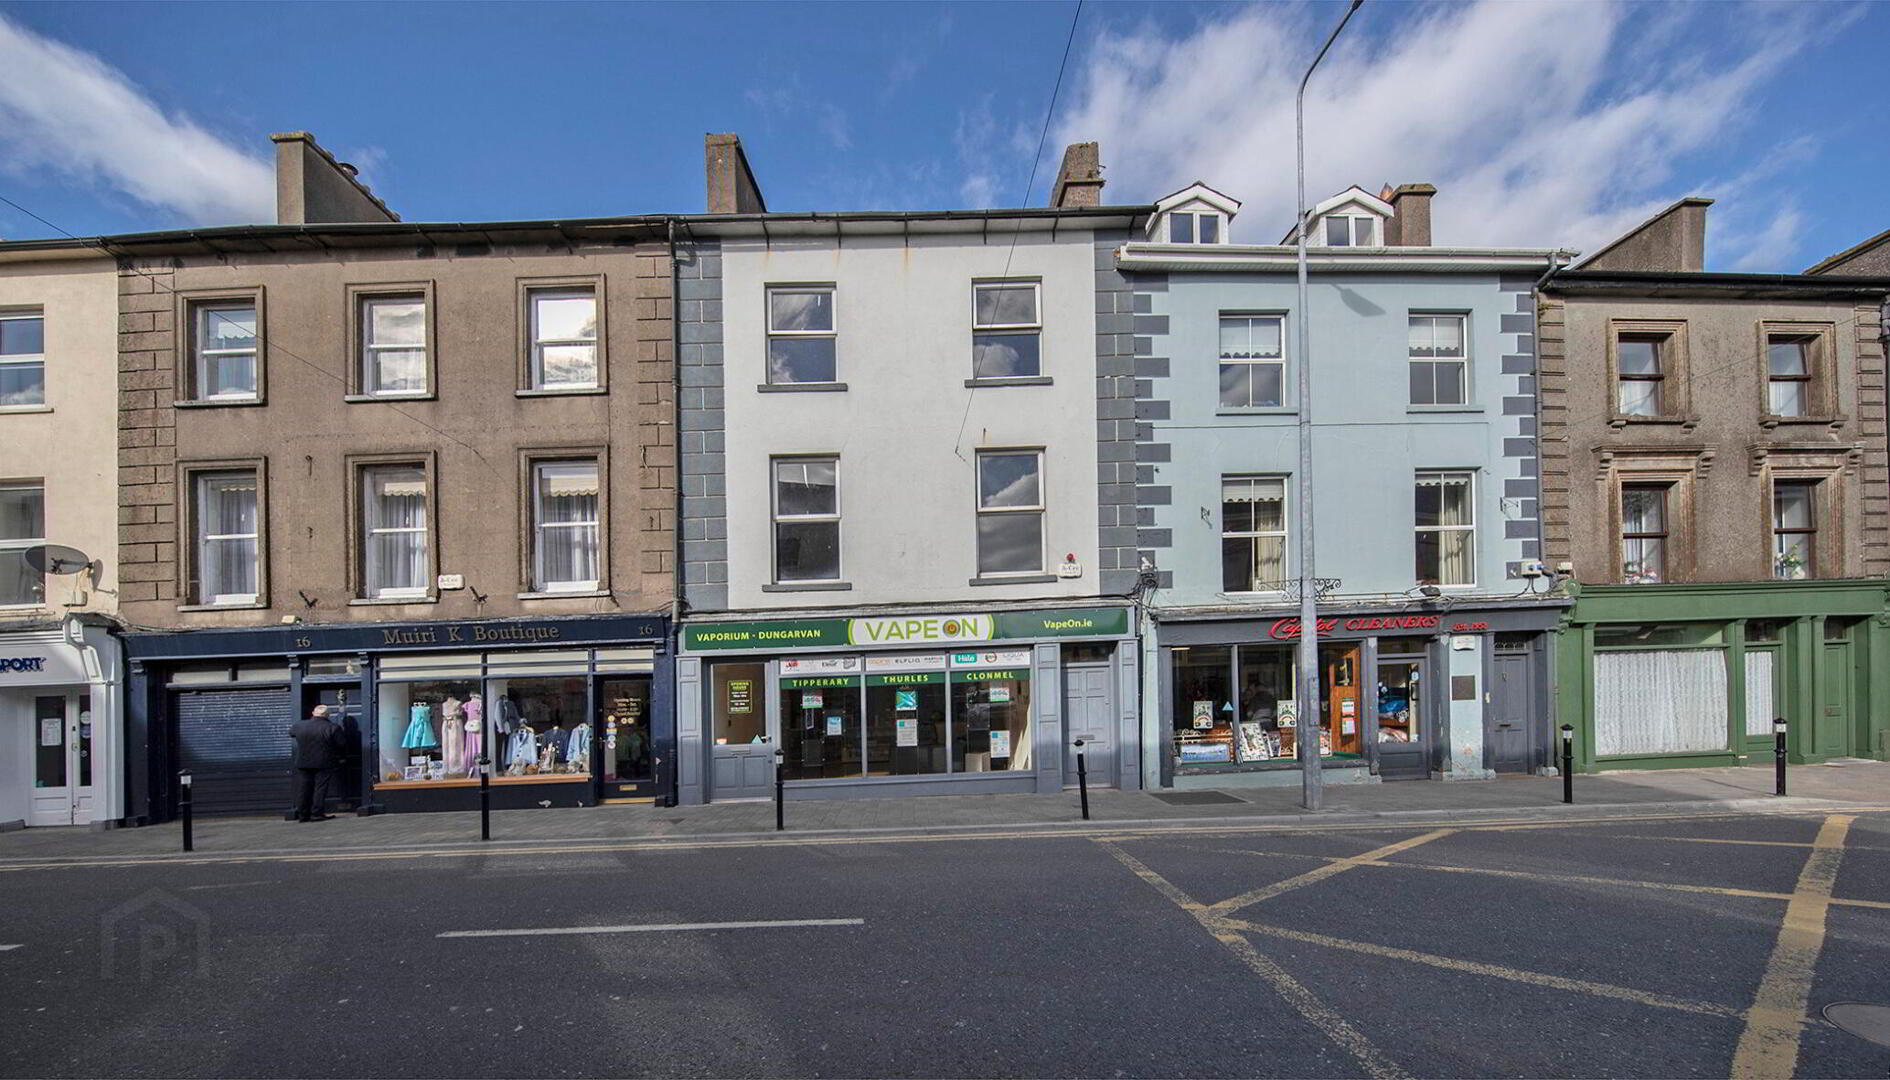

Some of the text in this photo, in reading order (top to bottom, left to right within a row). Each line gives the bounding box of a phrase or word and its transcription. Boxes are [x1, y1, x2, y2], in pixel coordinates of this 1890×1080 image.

[638, 624, 654, 635] 16
[1043, 618, 1093, 630] VapeOn.ie
[1269, 615, 1439, 640] Captol CLEANERS
[382, 624, 561, 645] Muiri K Boutique
[696, 632, 749, 642] VAPORIUM
[759, 629, 821, 640] DUNGARVAN
[295, 636, 311, 648] 16
[883, 674, 929, 684] THURLES
[966, 671, 1014, 681] CLONMEL
[792, 678, 849, 687] TIPPERARY
